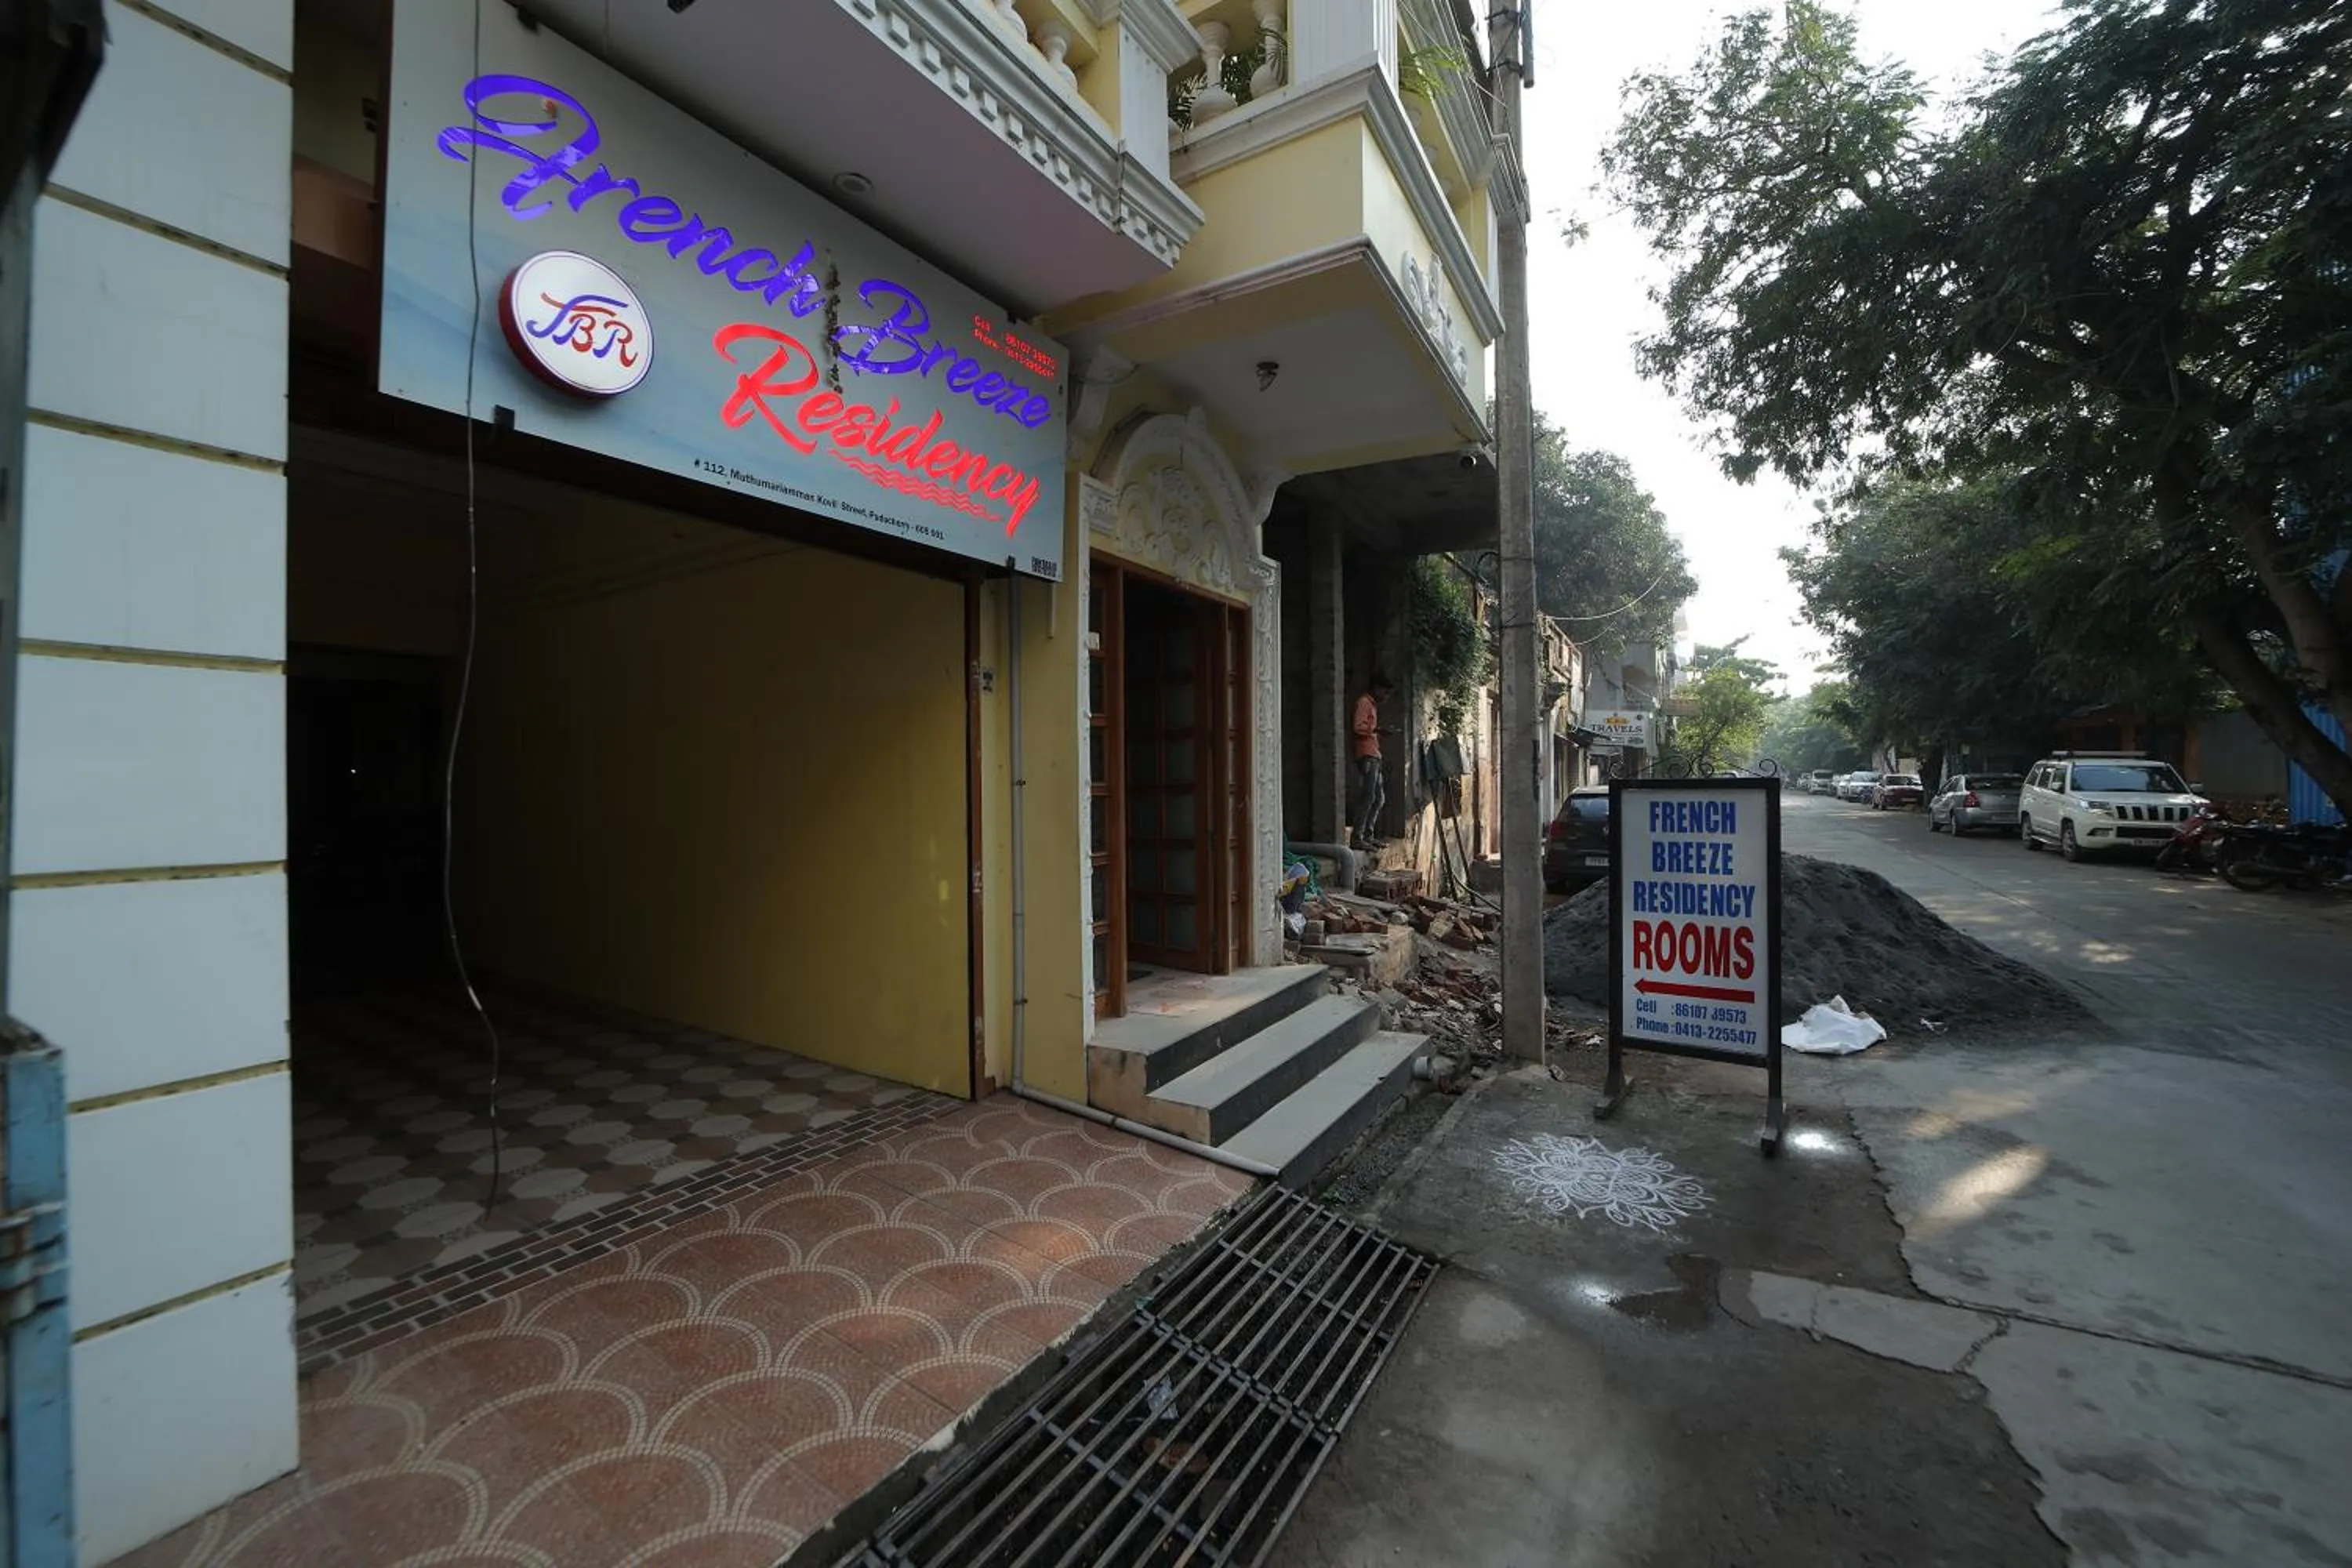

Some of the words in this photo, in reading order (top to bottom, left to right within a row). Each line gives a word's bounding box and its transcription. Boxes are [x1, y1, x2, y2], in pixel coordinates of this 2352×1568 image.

[436, 74, 828, 319] French
[829, 278, 1051, 429] Breeze
[713, 322, 1040, 536] Residency
[1649, 801, 1737, 835] FRENCH
[1651, 840, 1733, 876] BREEZE
[1633, 880, 1755, 918] RESIDENCY
[1633, 920, 1755, 980] ROOMS
[1636, 998, 1657, 1014] Cell
[1636, 1016, 1668, 1034] Phone
